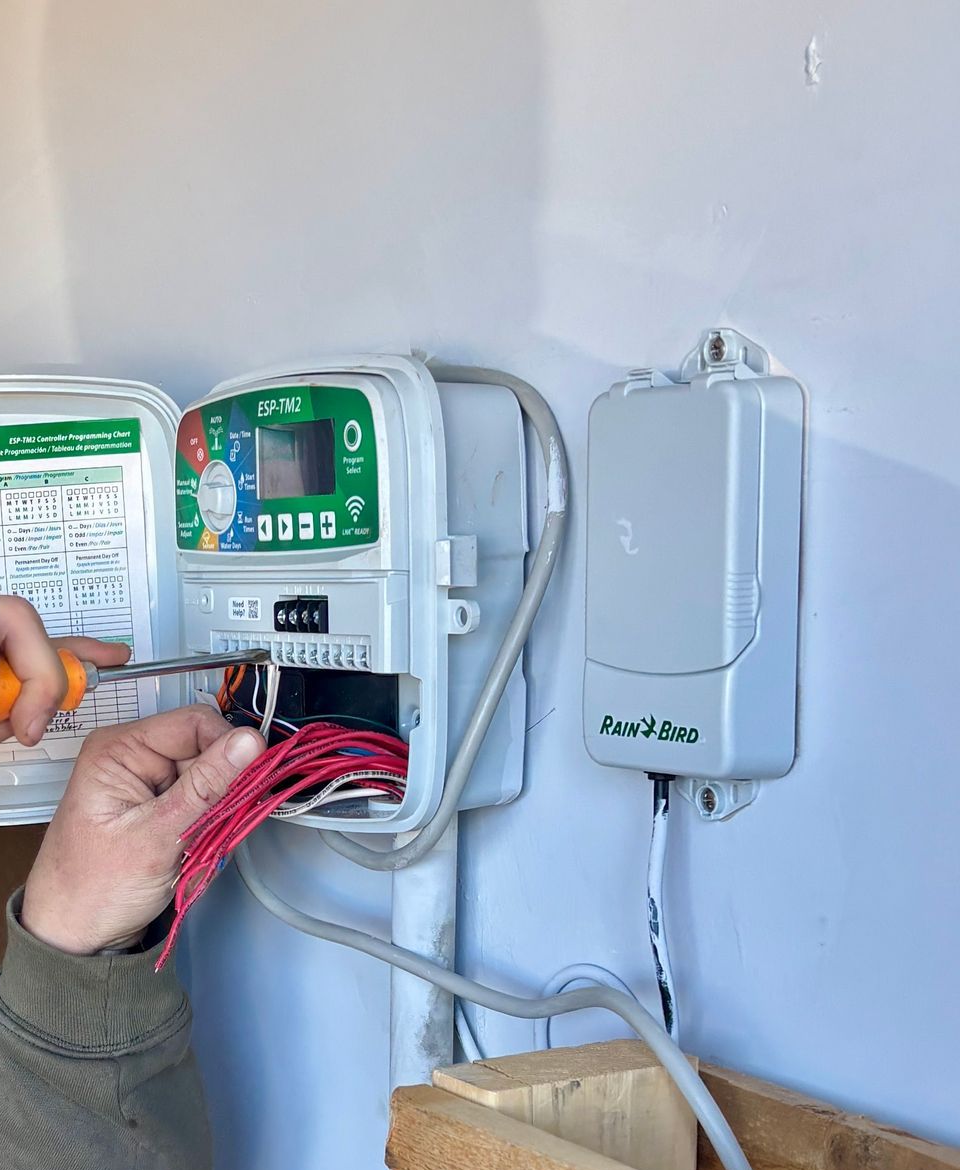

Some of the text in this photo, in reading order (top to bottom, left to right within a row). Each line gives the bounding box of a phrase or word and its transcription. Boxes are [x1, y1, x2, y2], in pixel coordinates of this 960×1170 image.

[258, 397, 301, 417] ESP-TM2
[37, 435, 68, 443] Controller
[69, 432, 112, 442] Programming
[343, 457, 364, 465] Program
[233, 600, 244, 608] Need
[233, 609, 246, 618] Help?
[600, 715, 699, 744] RAIN BIRD
